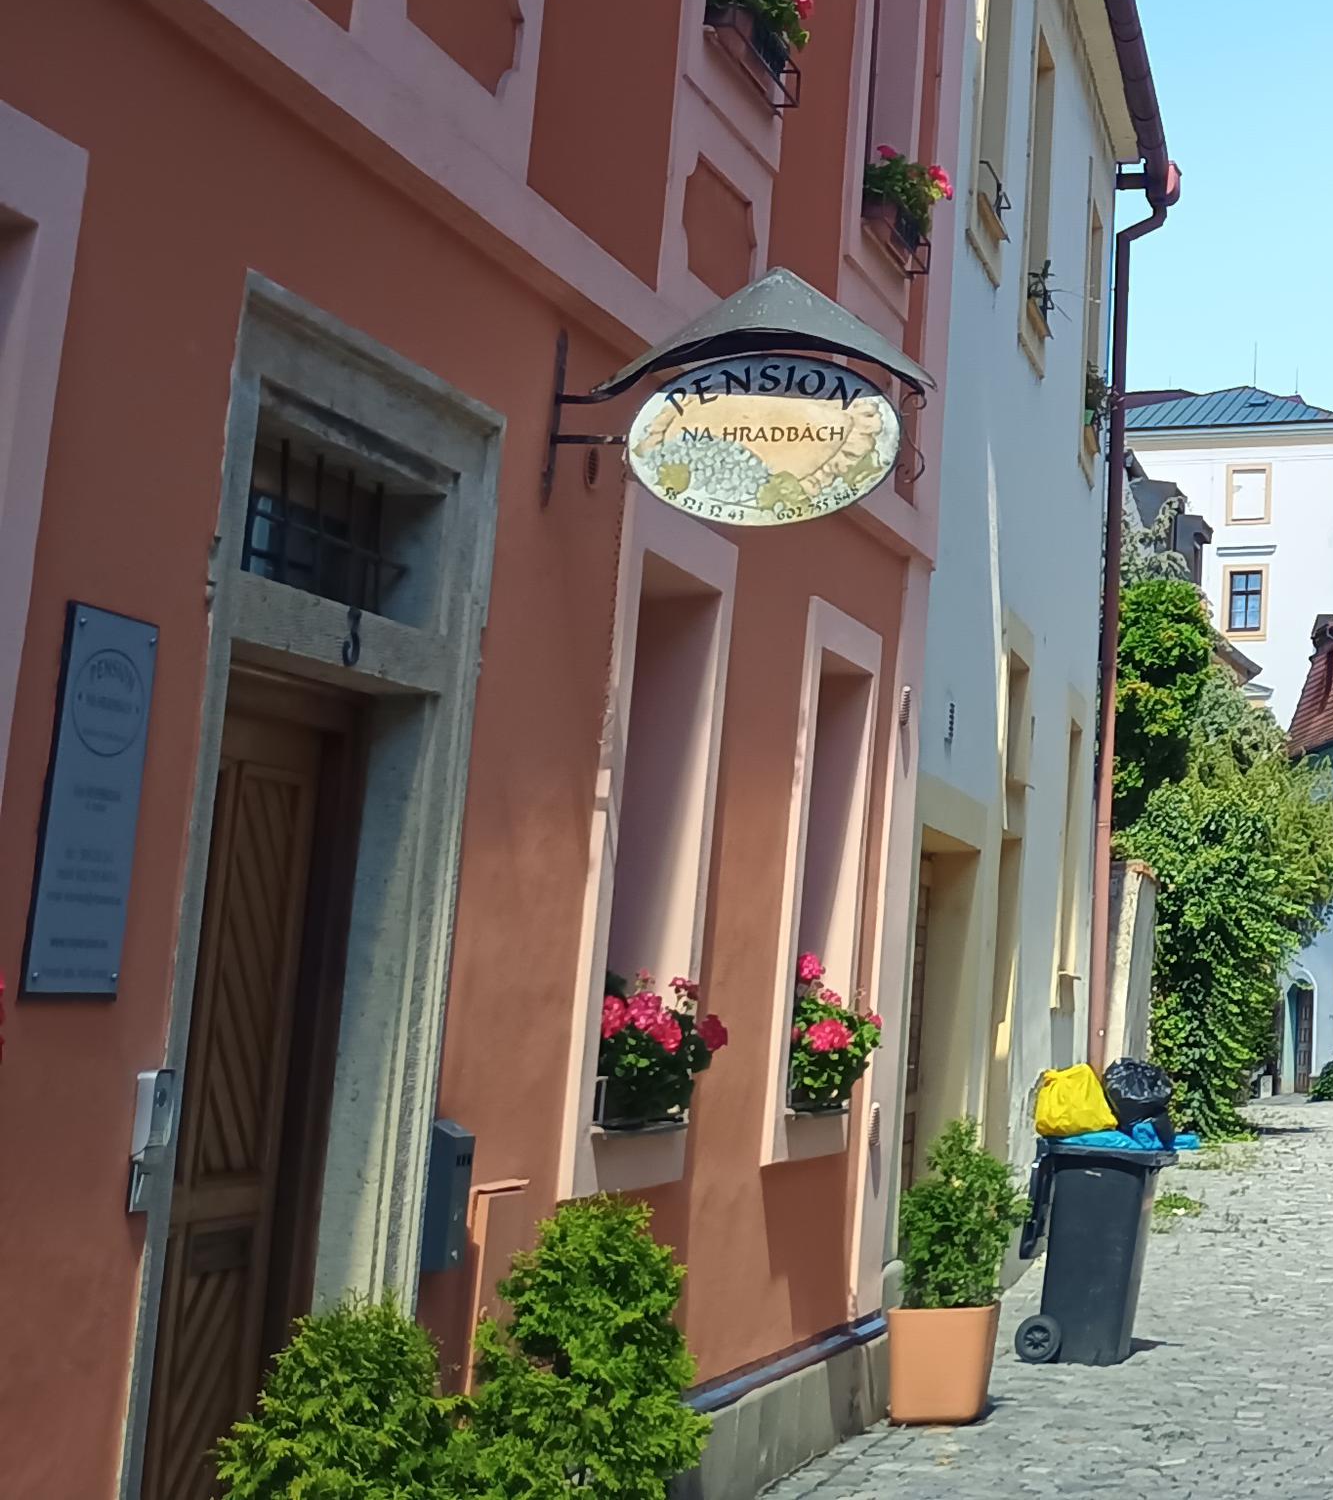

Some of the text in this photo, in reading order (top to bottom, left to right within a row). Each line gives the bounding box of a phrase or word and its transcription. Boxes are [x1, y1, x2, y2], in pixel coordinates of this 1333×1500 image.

[664, 364, 862, 417] PENSION
[681, 422, 845, 442] NA HRADBÁCH
